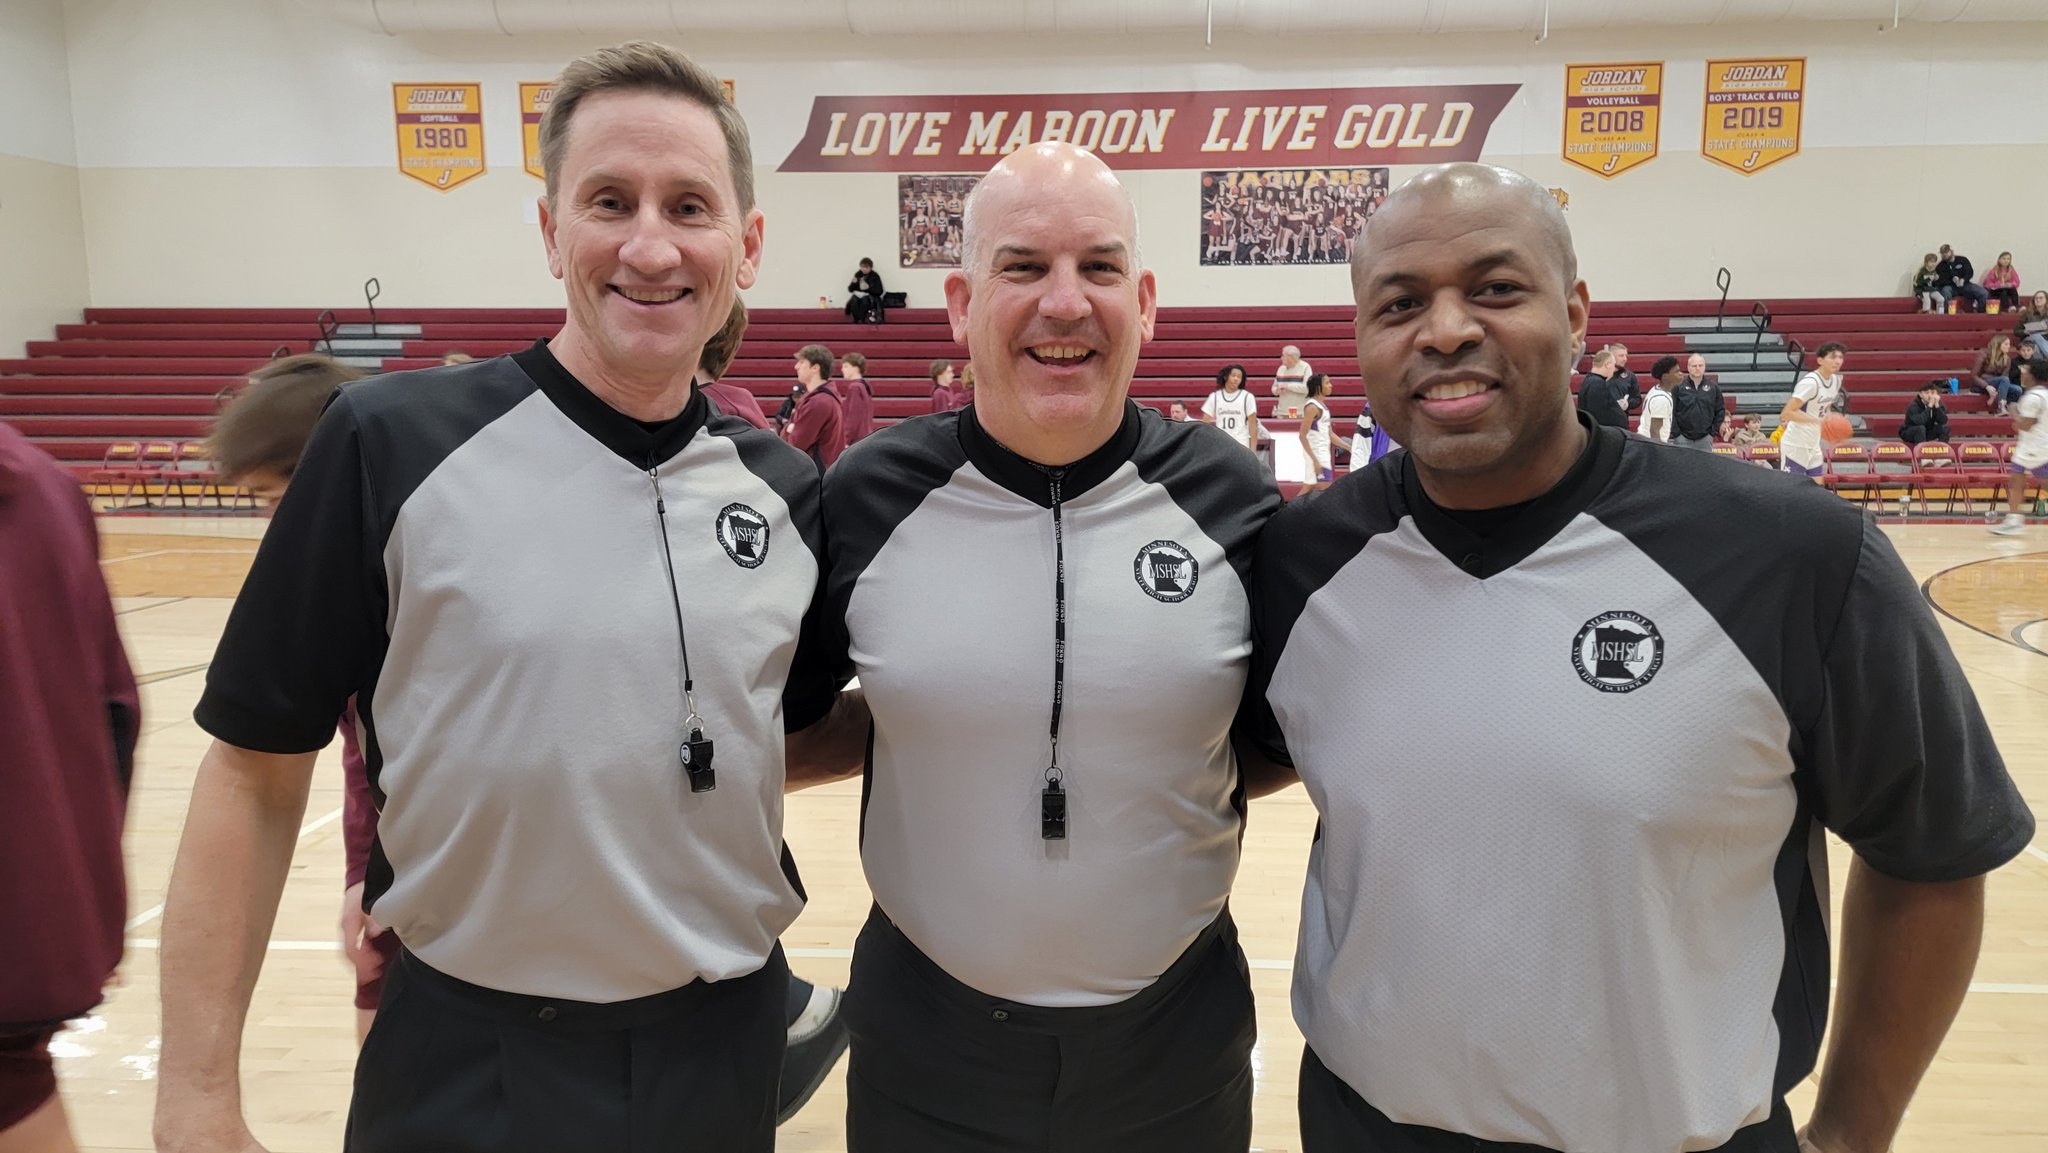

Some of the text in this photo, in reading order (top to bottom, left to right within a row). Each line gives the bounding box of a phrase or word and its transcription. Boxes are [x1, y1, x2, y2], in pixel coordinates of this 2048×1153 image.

[1581, 69, 1647, 86] JORDAN
[1722, 65, 1788, 81] JORDAN
[408, 89, 466, 104] JORDAN
[1587, 96, 1639, 105] VOLLEYBALL
[1709, 91, 1799, 102] BOYS' TRACK & FIELD
[420, 114, 459, 123] SOFTBALL
[1580, 110, 1644, 133] 2008
[1723, 106, 1783, 129] 2019
[820, 101, 1474, 156] LOVE MAROON LIVE GOLD
[415, 128, 468, 148] 1980
[1708, 137, 1794, 150] STATE CHAMPIONS
[1568, 141, 1652, 154] STATE CHAMPIONS
[1603, 154, 1620, 171] J
[1743, 151, 1761, 168] J
[437, 169, 453, 185] J
[1226, 169, 1371, 189] JAGUARS
[1222, 417, 1236, 429] 10
[728, 525, 761, 546] MSHSL
[1141, 541, 1188, 557] MINNESOTA
[1148, 563, 1187, 579] MSHSL
[1585, 612, 1653, 630] MINNESOTA
[1590, 640, 1644, 662] MSHSL
